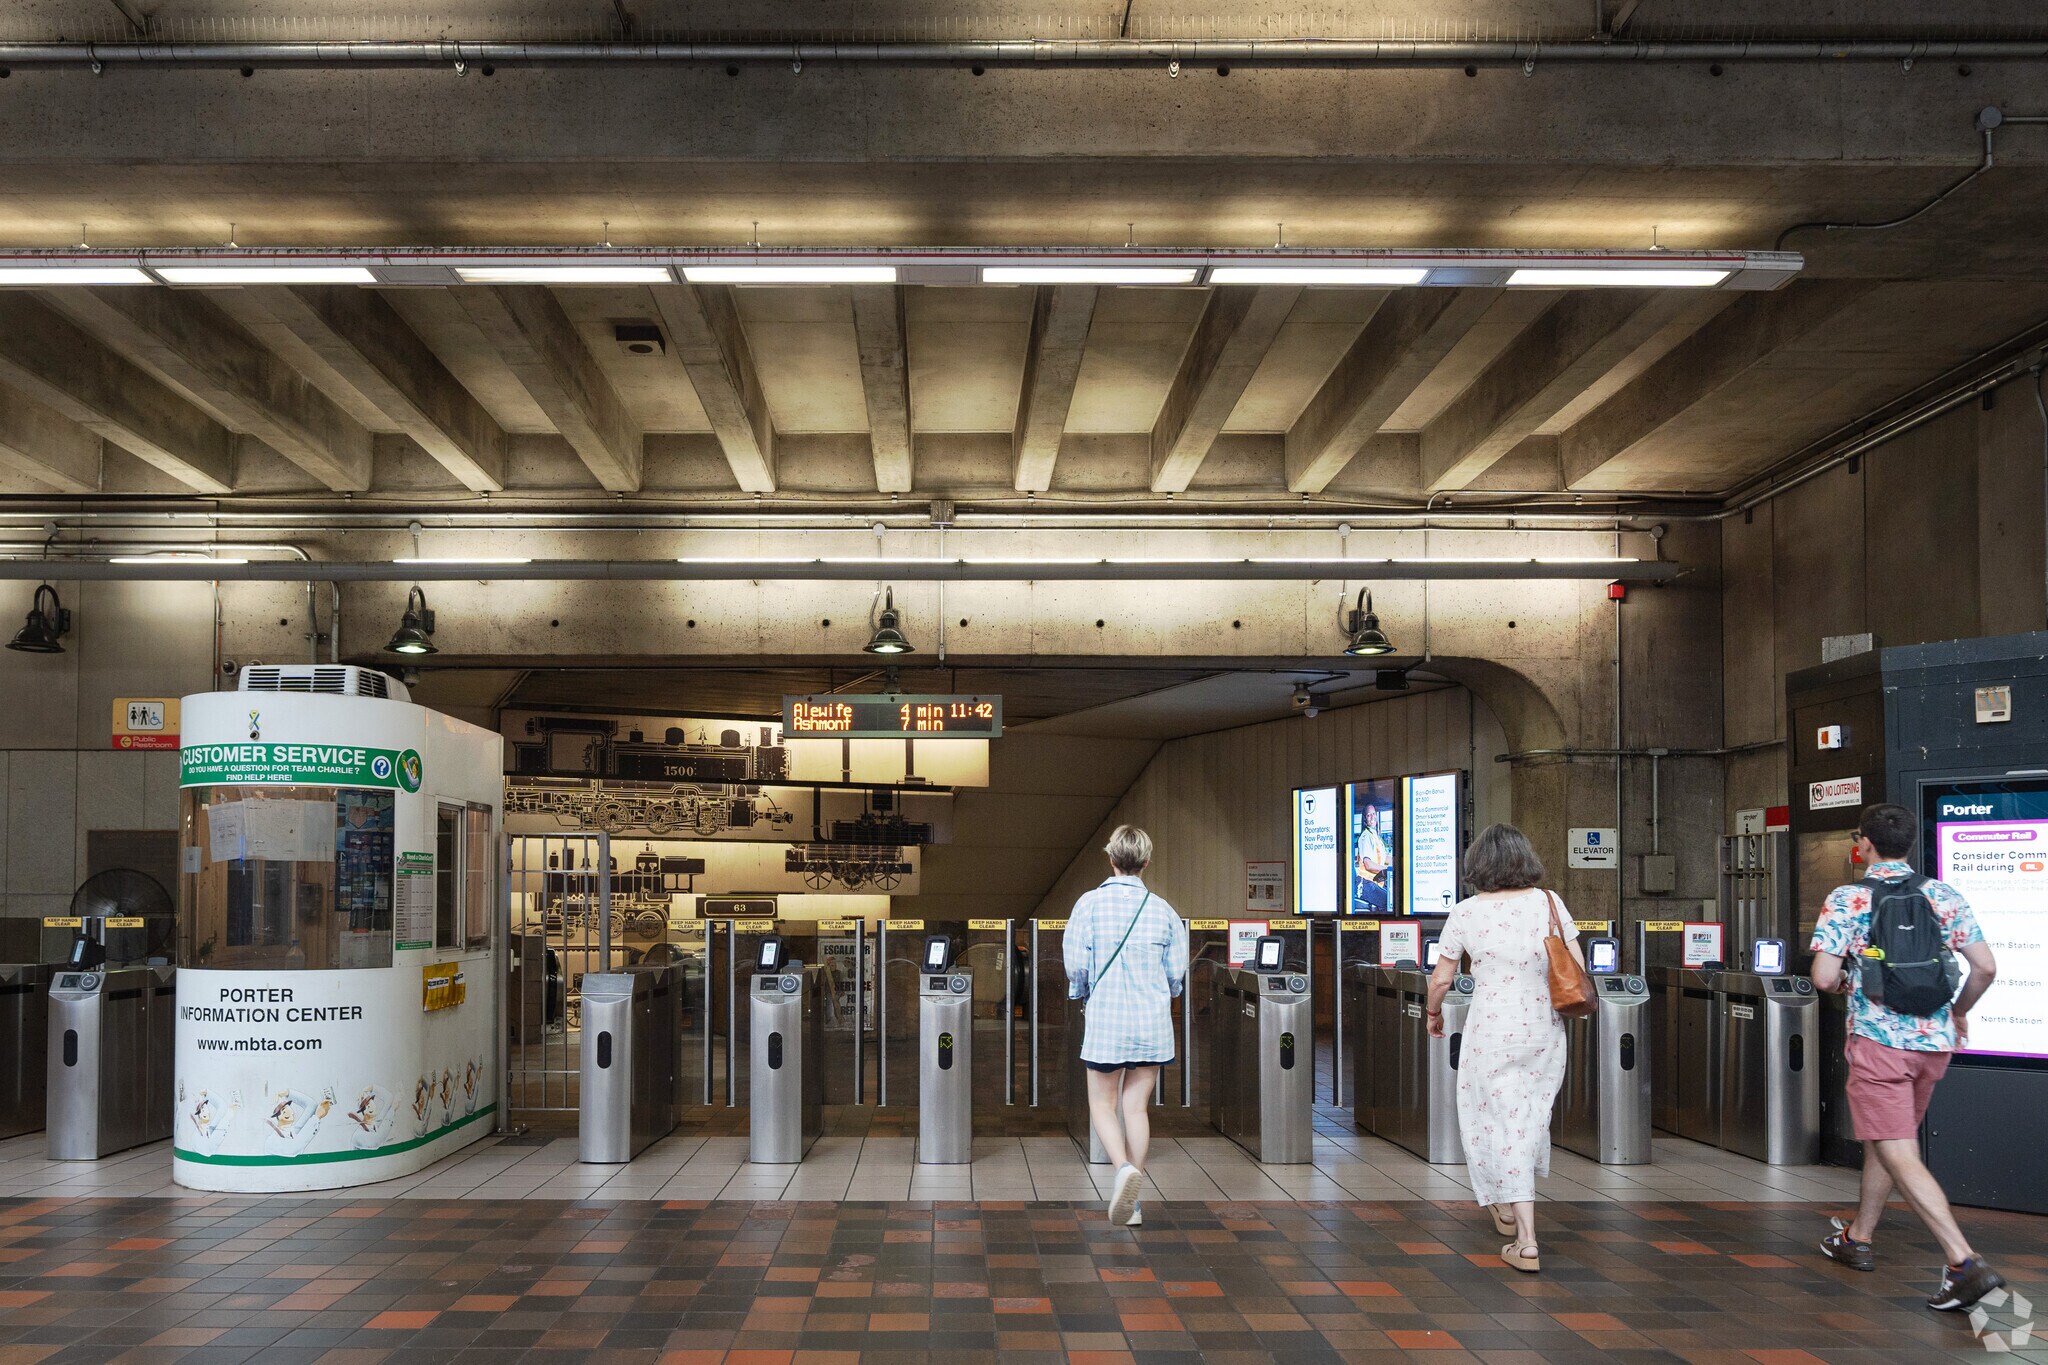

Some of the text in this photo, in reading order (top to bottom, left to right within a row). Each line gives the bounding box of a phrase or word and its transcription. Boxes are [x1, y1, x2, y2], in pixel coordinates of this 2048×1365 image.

[794, 704, 992, 718] Alewife 4 min 11:42
[794, 718, 943, 730] Ashmont 7 min
[183, 746, 366, 766] CUSTOMER SERVICE
[318, 766, 353, 774] CHARLIE
[664, 766, 694, 776] 1500
[1826, 782, 1859, 796] NO LOITERING
[1306, 800, 1313, 810] T
[1943, 804, 1993, 816] Porter
[1953, 851, 2047, 860] Consider Comm
[1977, 863, 2014, 873] during
[1443, 895, 1450, 904] T
[824, 945, 870, 955] ESCALAR
[220, 988, 293, 1003] PORTER
[181, 1006, 362, 1023] INFORMATION CENTER
[841, 1006, 867, 1015] REPR
[198, 1038, 322, 1051] www.mbta.com
